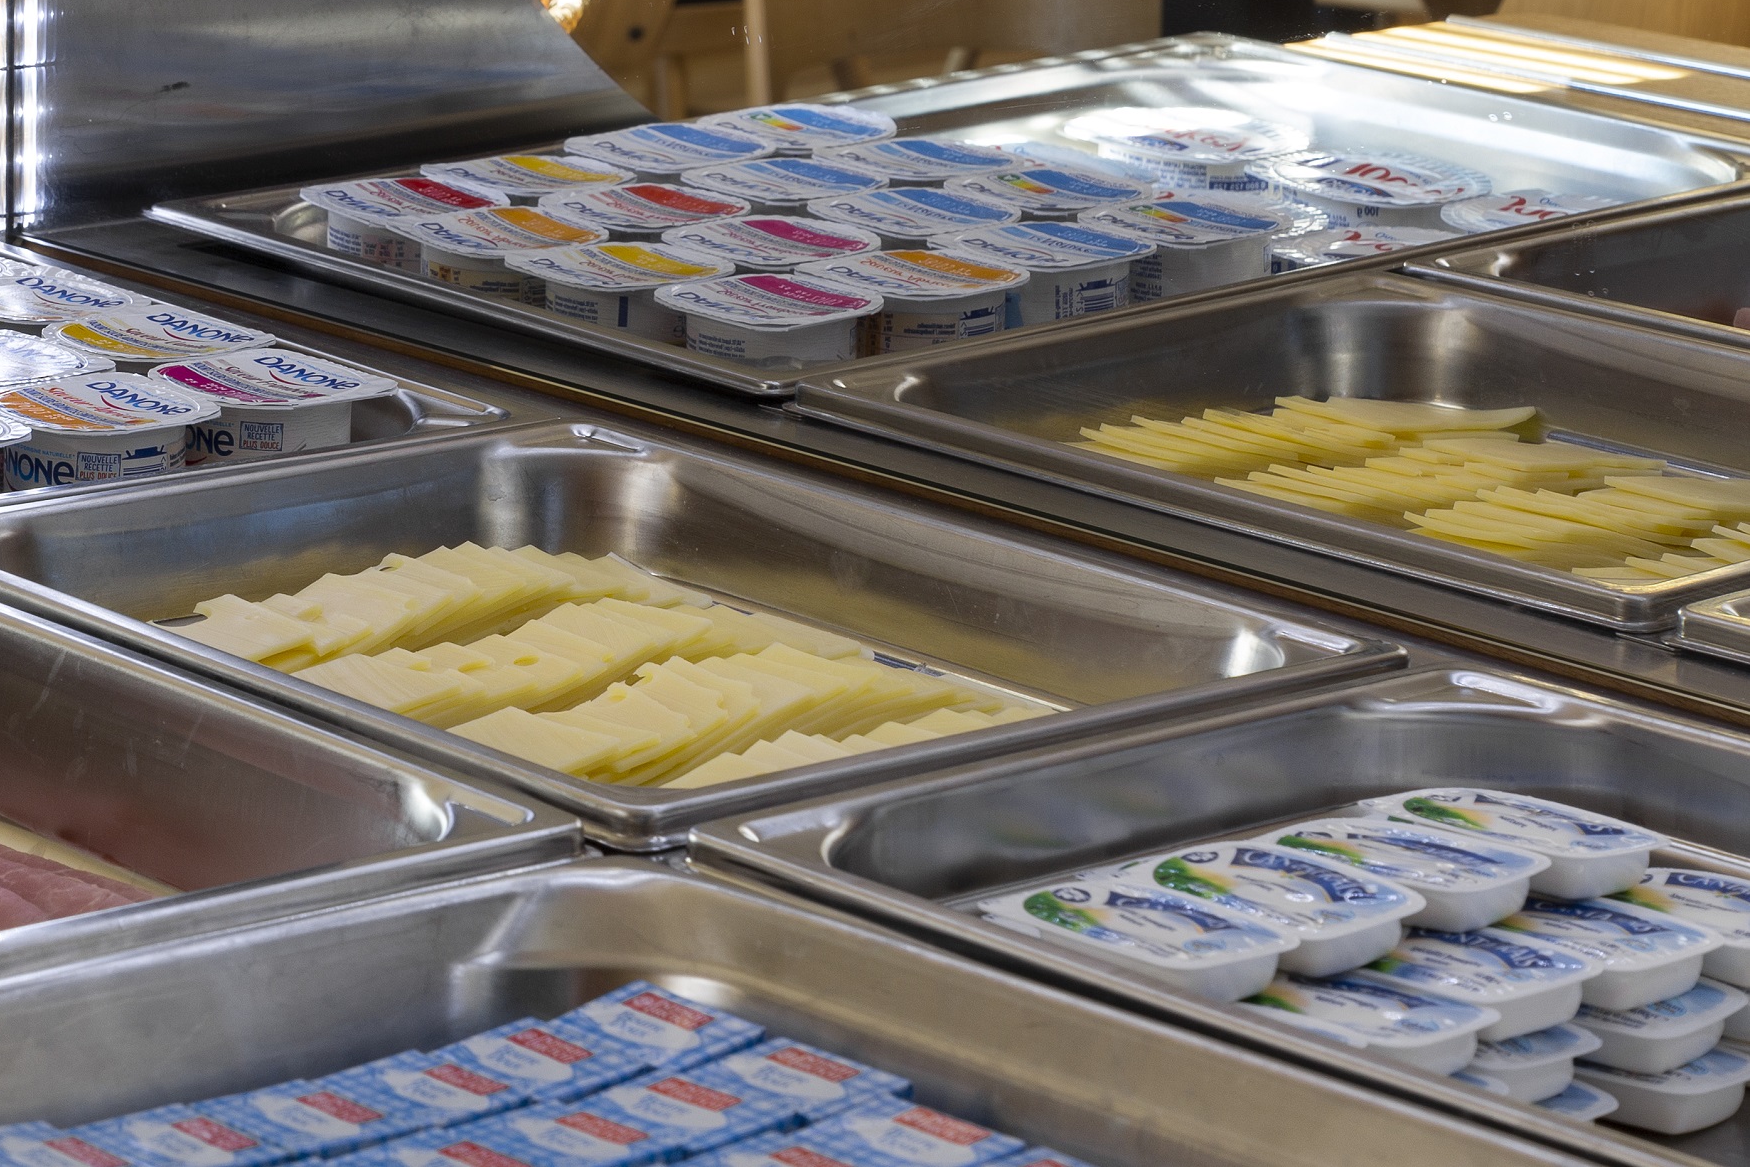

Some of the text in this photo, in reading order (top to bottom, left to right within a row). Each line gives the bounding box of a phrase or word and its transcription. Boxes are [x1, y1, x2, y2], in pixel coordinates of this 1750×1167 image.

[16, 277, 125, 308] DANONE
[146, 312, 255, 344] DANONE
[254, 356, 361, 390] DANONE
[85, 381, 192, 416] DANONE
[244, 424, 280, 434] NOUVELLE
[247, 432, 275, 441] RECETTE
[243, 439, 279, 450] PLUS DOUCE
[81, 454, 118, 465] NOUVELLE
[83, 463, 113, 472] RECETTE
[79, 471, 95, 479] PLUS
